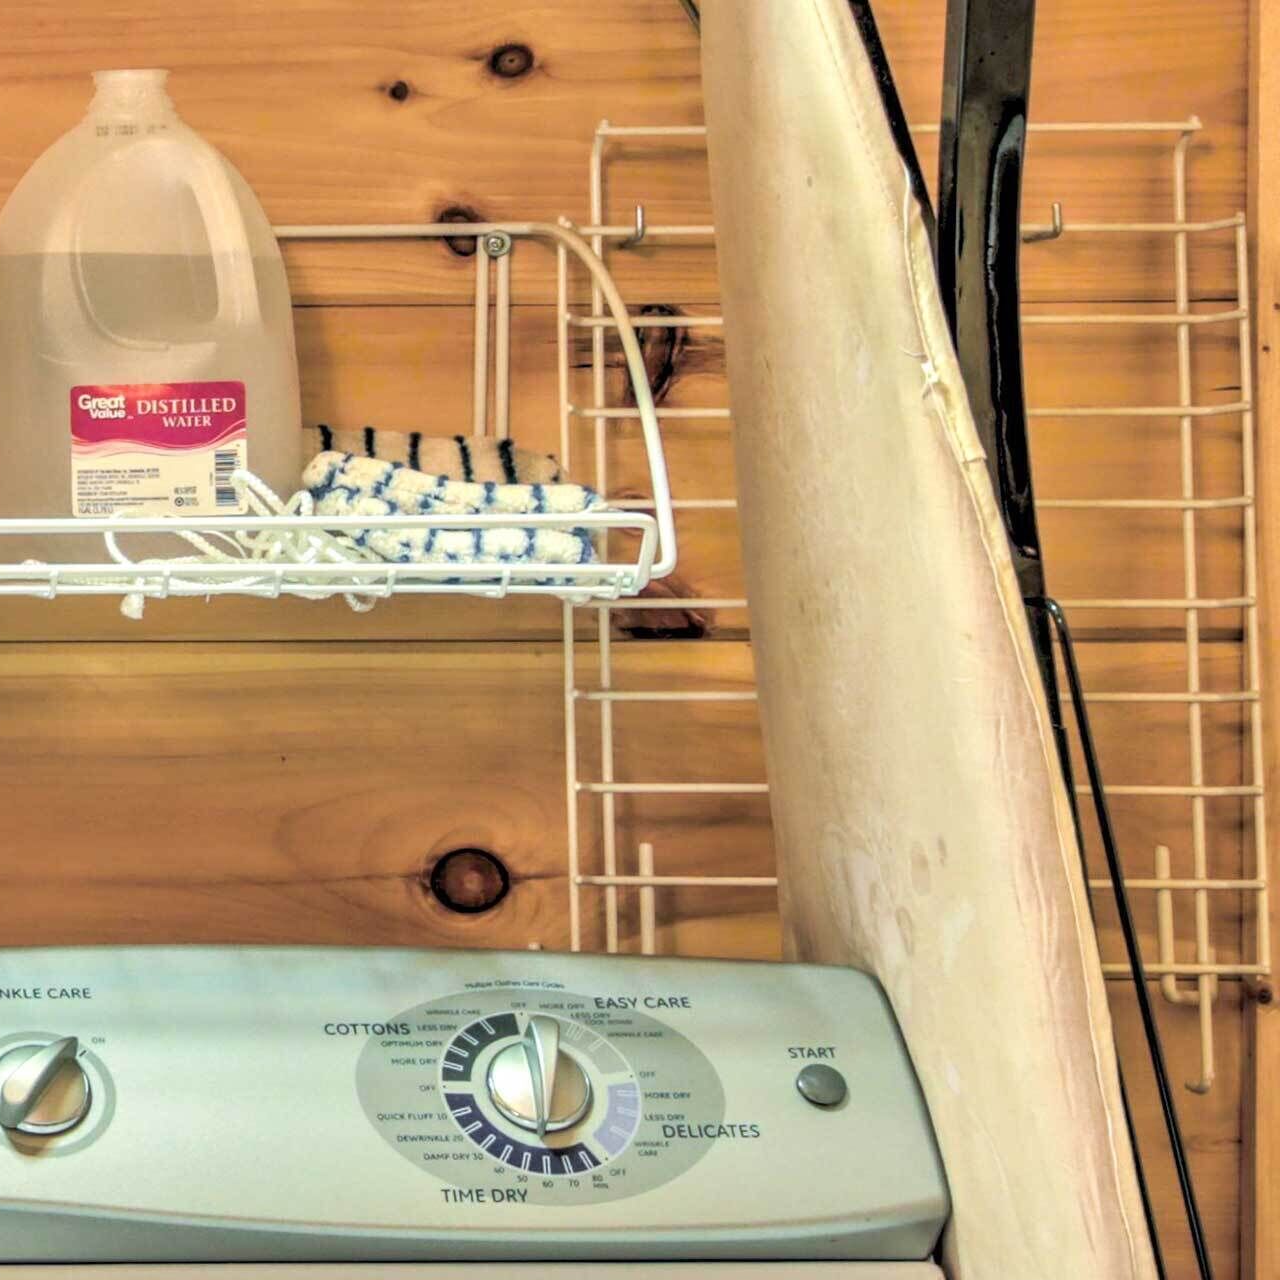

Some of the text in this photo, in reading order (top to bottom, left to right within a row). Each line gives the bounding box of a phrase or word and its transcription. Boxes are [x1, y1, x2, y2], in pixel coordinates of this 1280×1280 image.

[77, 394, 126, 410] Great
[136, 397, 237, 415] DISTILLED
[90, 407, 126, 419] Value
[162, 416, 212, 428] WATER
[47, 987, 92, 999] CARE
[594, 996, 691, 1009] EASY CARE
[324, 1023, 411, 1036] COTTONS
[787, 1047, 837, 1059] START
[419, 1084, 436, 1092] OFF
[377, 1113, 405, 1121] QUICK
[662, 1125, 761, 1139] DELICATES
[517, 1175, 528, 1183] 50
[441, 1189, 528, 1203] TIME DRY
